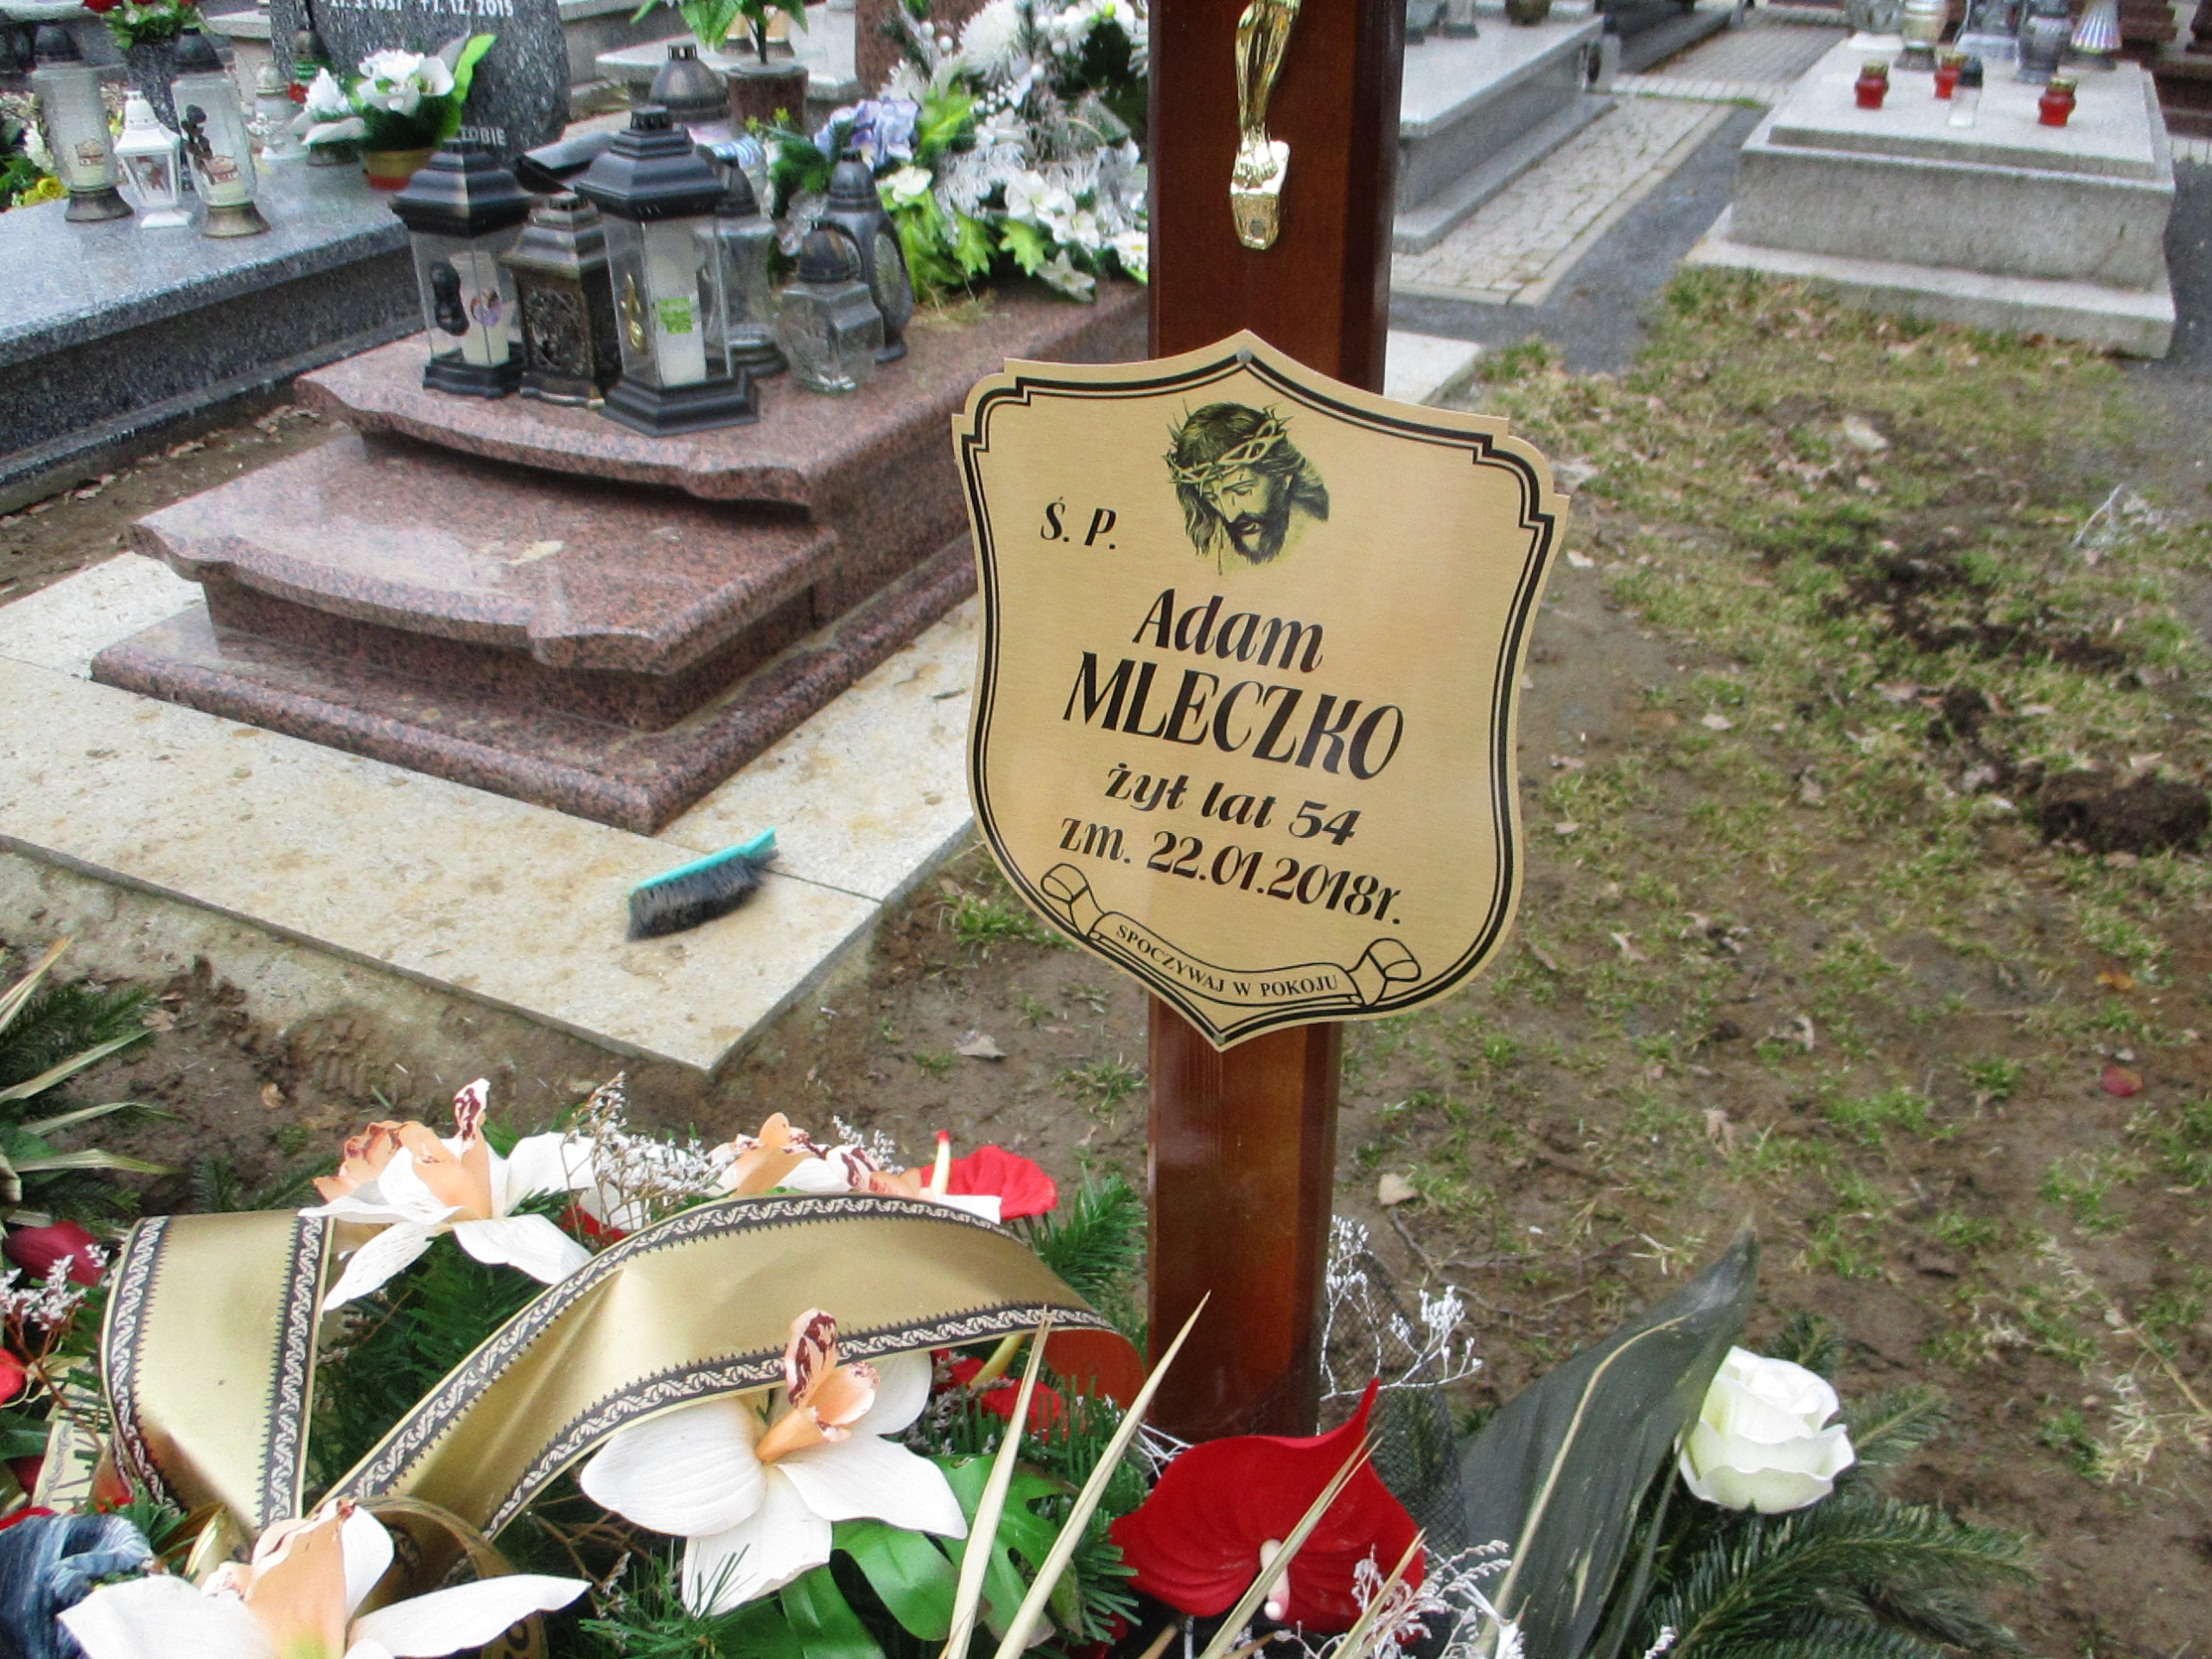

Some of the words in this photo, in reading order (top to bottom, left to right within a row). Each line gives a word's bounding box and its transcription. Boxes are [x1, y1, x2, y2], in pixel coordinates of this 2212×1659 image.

[1039, 495, 1070, 543] Ś.
[1084, 506, 1117, 550] P.
[1131, 587, 1325, 674] Adam
[1062, 651, 1404, 781] MLECZKO
[1201, 781, 1277, 829] lat
[1288, 800, 1362, 846] 54
[1058, 817, 1132, 864] zm.
[1147, 830, 1402, 925] 22.01.2018r.
[1116, 924, 1225, 993] SPOCZYWAJ
[1231, 982, 1252, 996] W
[1259, 975, 1338, 996] POKOJU
